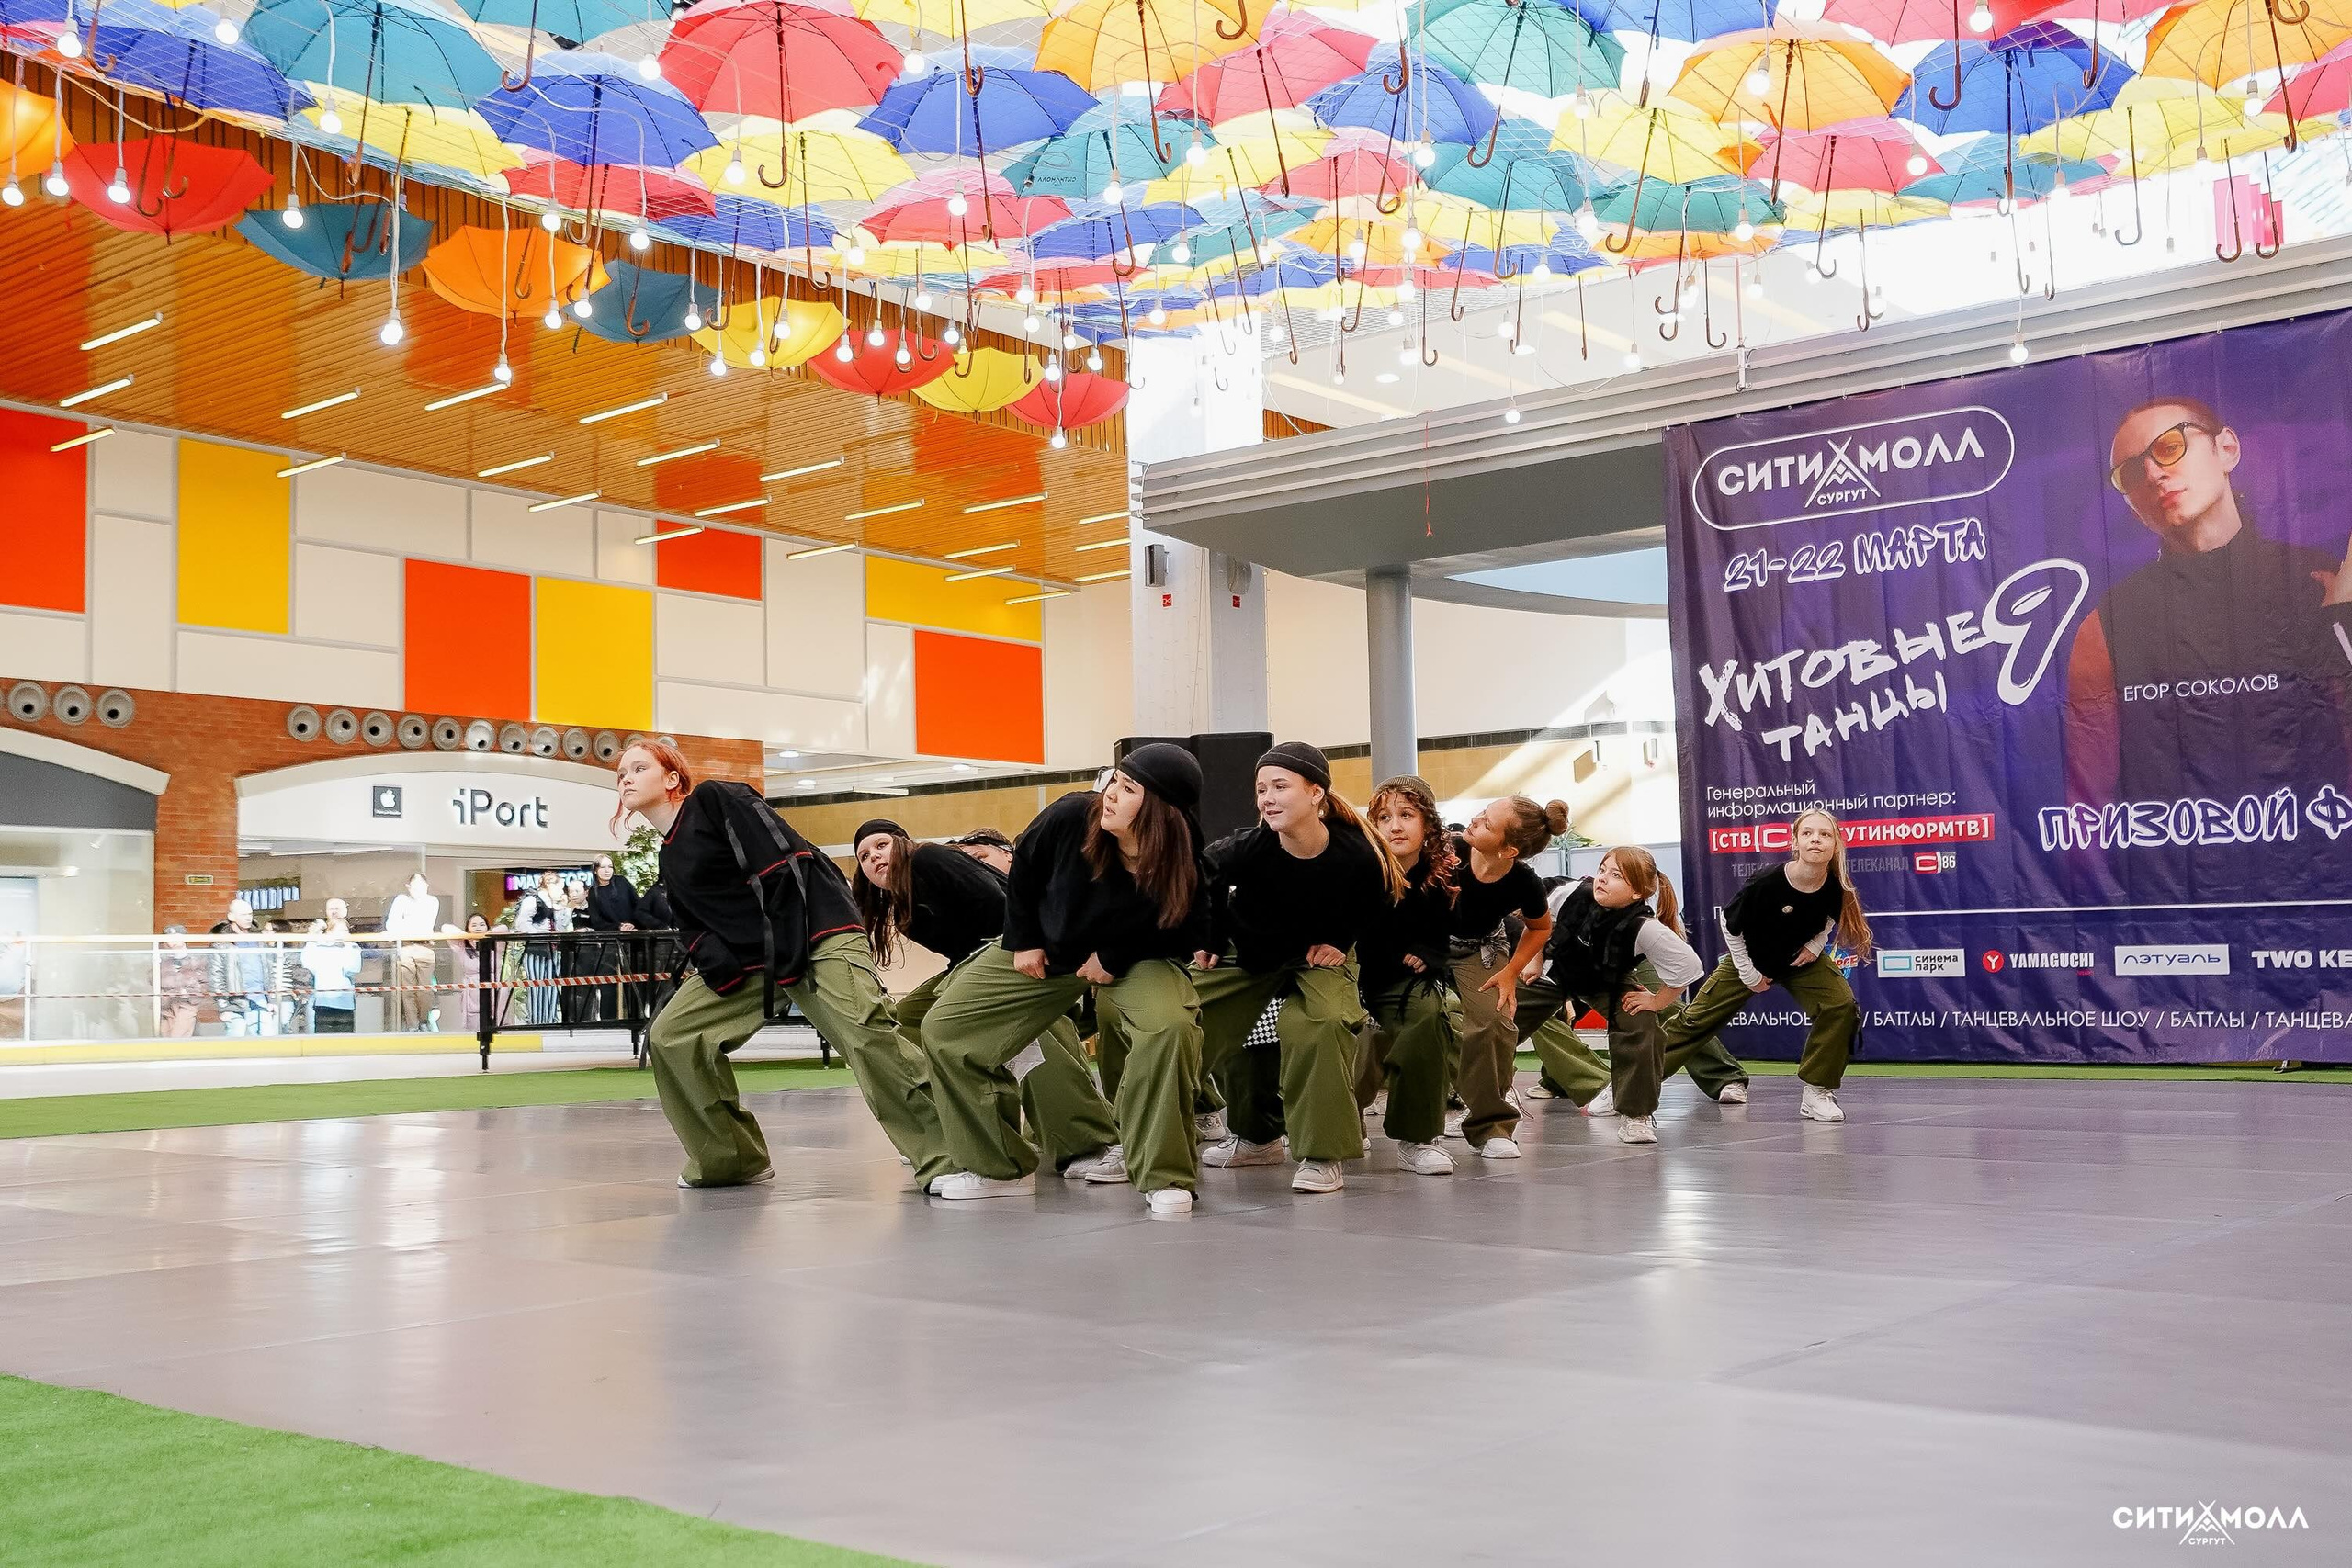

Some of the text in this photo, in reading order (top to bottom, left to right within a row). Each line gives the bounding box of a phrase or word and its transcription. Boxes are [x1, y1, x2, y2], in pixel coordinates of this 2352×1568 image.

[1816, 488, 1868, 506] СУРГУТ
[1723, 517, 1987, 592] 21-22 МАРТА
[2123, 673, 2279, 702] ЕГОР СОКОЛОВ
[1761, 671, 1947, 761] ТАНЦЫ
[1706, 780, 1815, 801] Генеральный
[452, 788, 549, 828] iPort
[1707, 791, 1957, 820] информационный партнер:
[1839, 816, 1989, 842] УТИНФОРМТВ]
[2037, 786, 2298, 852] ПРИЗОВОЙ
[1915, 953, 1959, 964] синема
[1915, 964, 1946, 974] парк
[2009, 952, 2095, 969] YAMAGUCHI
[2251, 949, 2313, 969] TWO
[1727, 1011, 1813, 1027] ЕВАЛЬНОЕ
[1873, 1011, 1935, 1027] БАТТЛЫ
[1952, 1011, 2096, 1028] ТАНЦЕВАЛЬНОЕ
[2101, 1011, 2151, 1028] ШОУ
[2170, 1011, 2245, 1028] БАТТЛЫ
